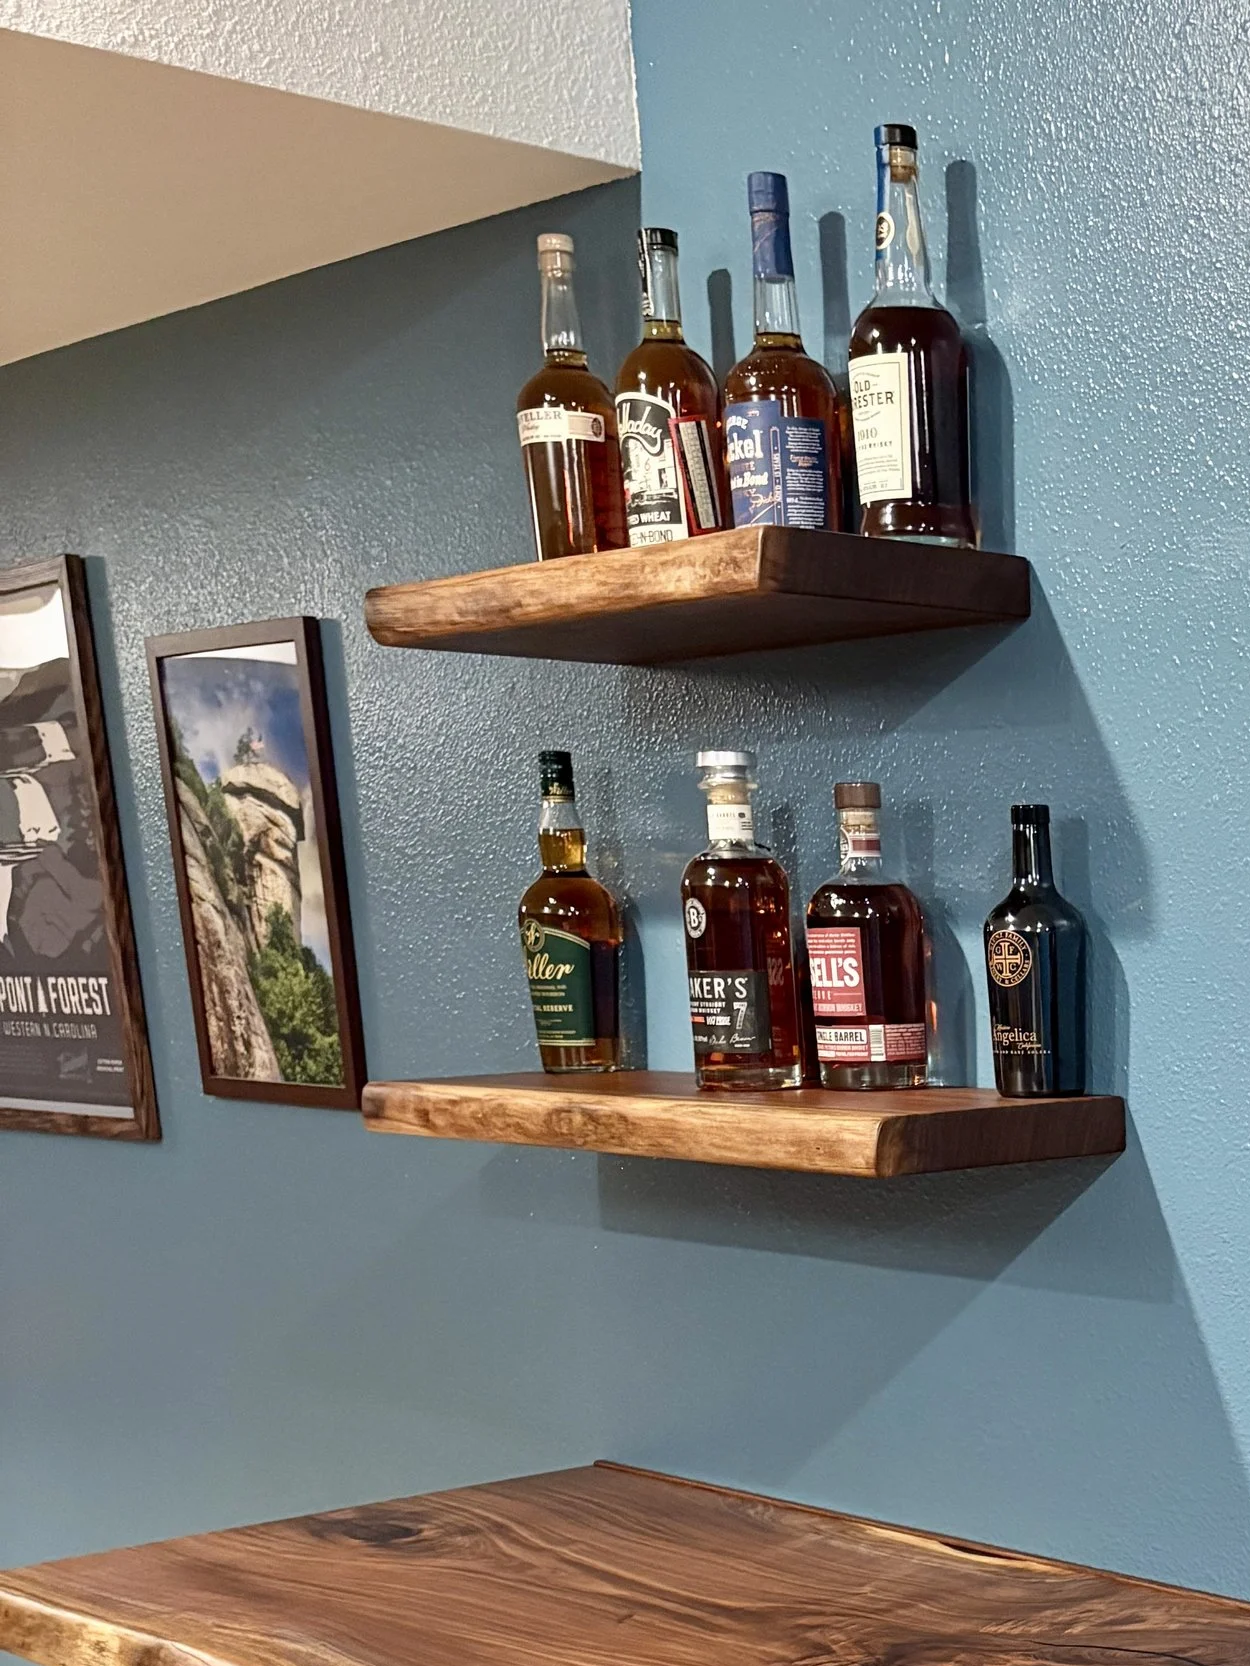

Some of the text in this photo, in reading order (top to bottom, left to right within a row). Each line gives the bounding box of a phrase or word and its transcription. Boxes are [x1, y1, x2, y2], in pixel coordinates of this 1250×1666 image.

[853, 380, 871, 394] OLD
[640, 511, 671, 524] WHEAT
[689, 907, 699, 928] B
[1005, 931, 1027, 951] FAMILY
[1009, 962, 1017, 971] C
[47, 976, 111, 1016] FOREST
[542, 1004, 574, 1012] RESERVE
[733, 1001, 748, 1030] 7
[2, 1021, 42, 1037] WESTERN
[52, 1022, 98, 1039] CAROLINA
[834, 1031, 865, 1042] BARREL
[993, 1027, 1038, 1046] Angelica
